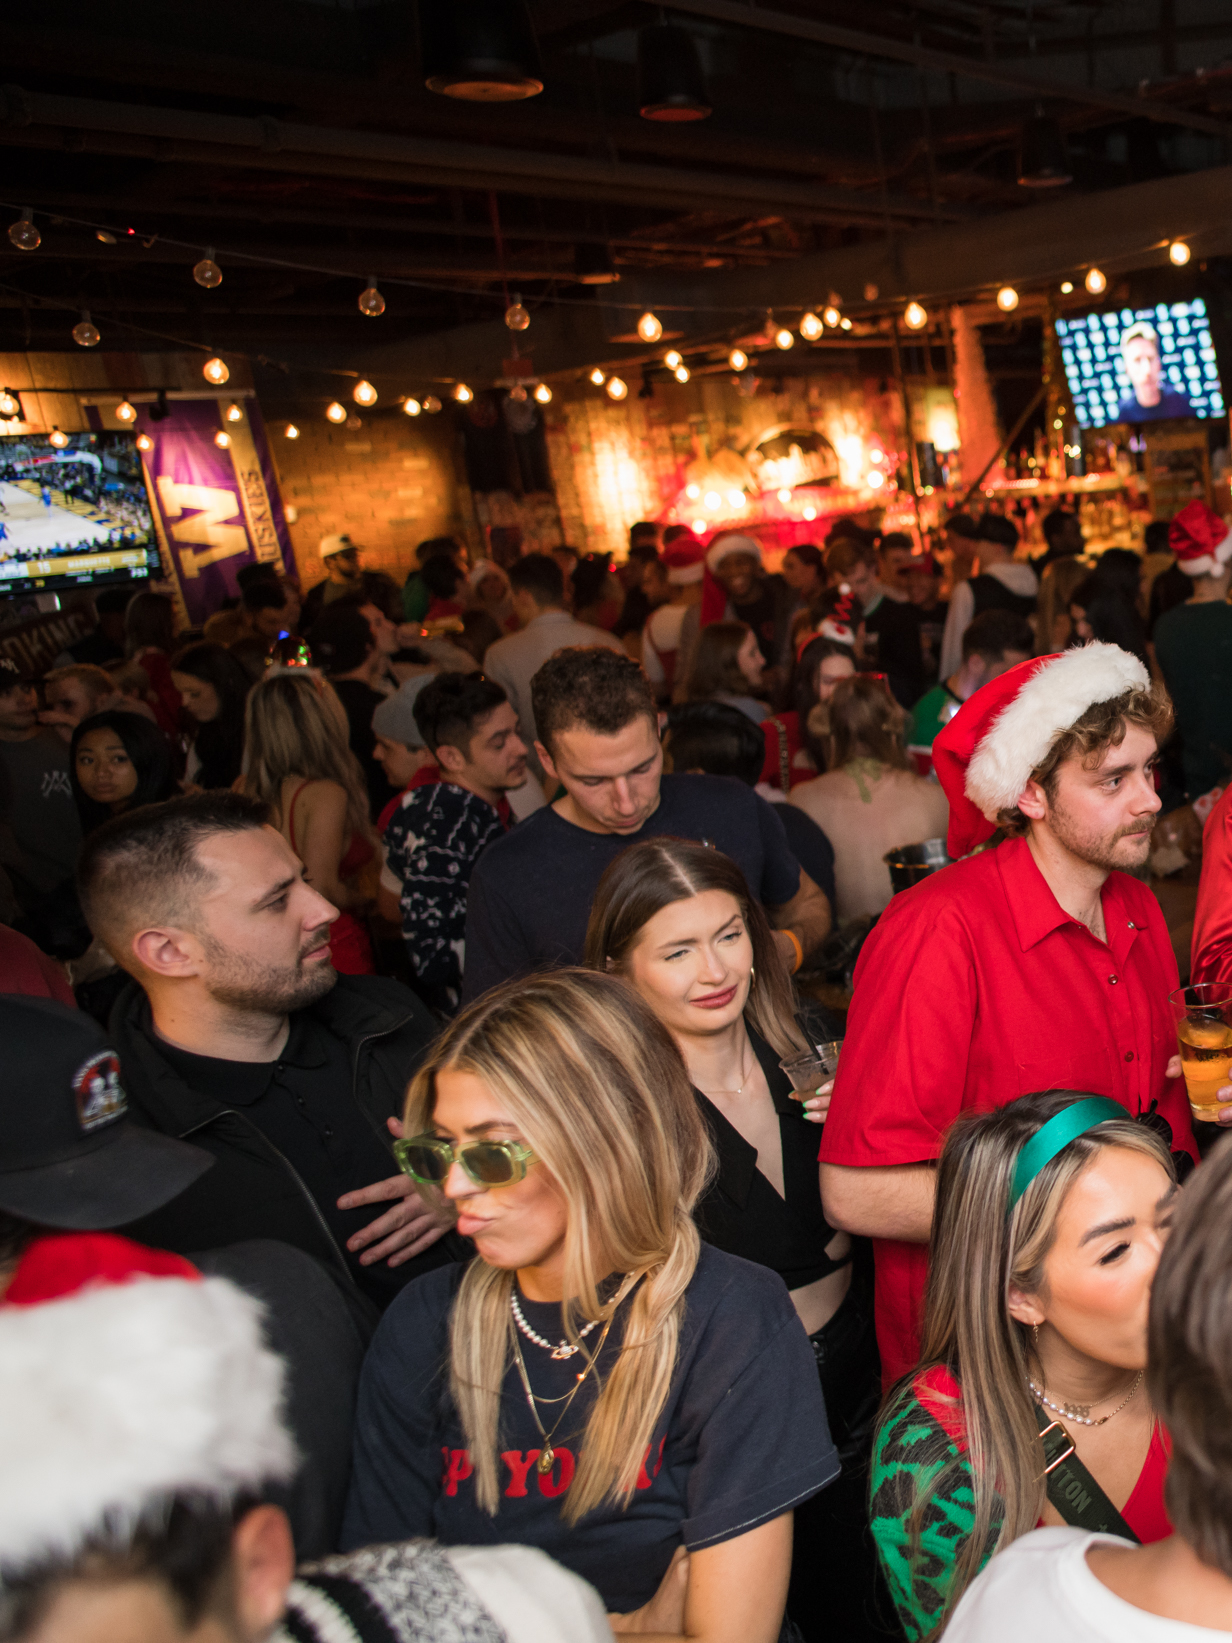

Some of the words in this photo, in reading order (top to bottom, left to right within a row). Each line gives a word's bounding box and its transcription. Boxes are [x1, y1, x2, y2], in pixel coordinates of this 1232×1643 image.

[156, 475, 250, 579] W
[241, 468, 282, 565] USKIES
[441, 1446, 477, 1498] P
